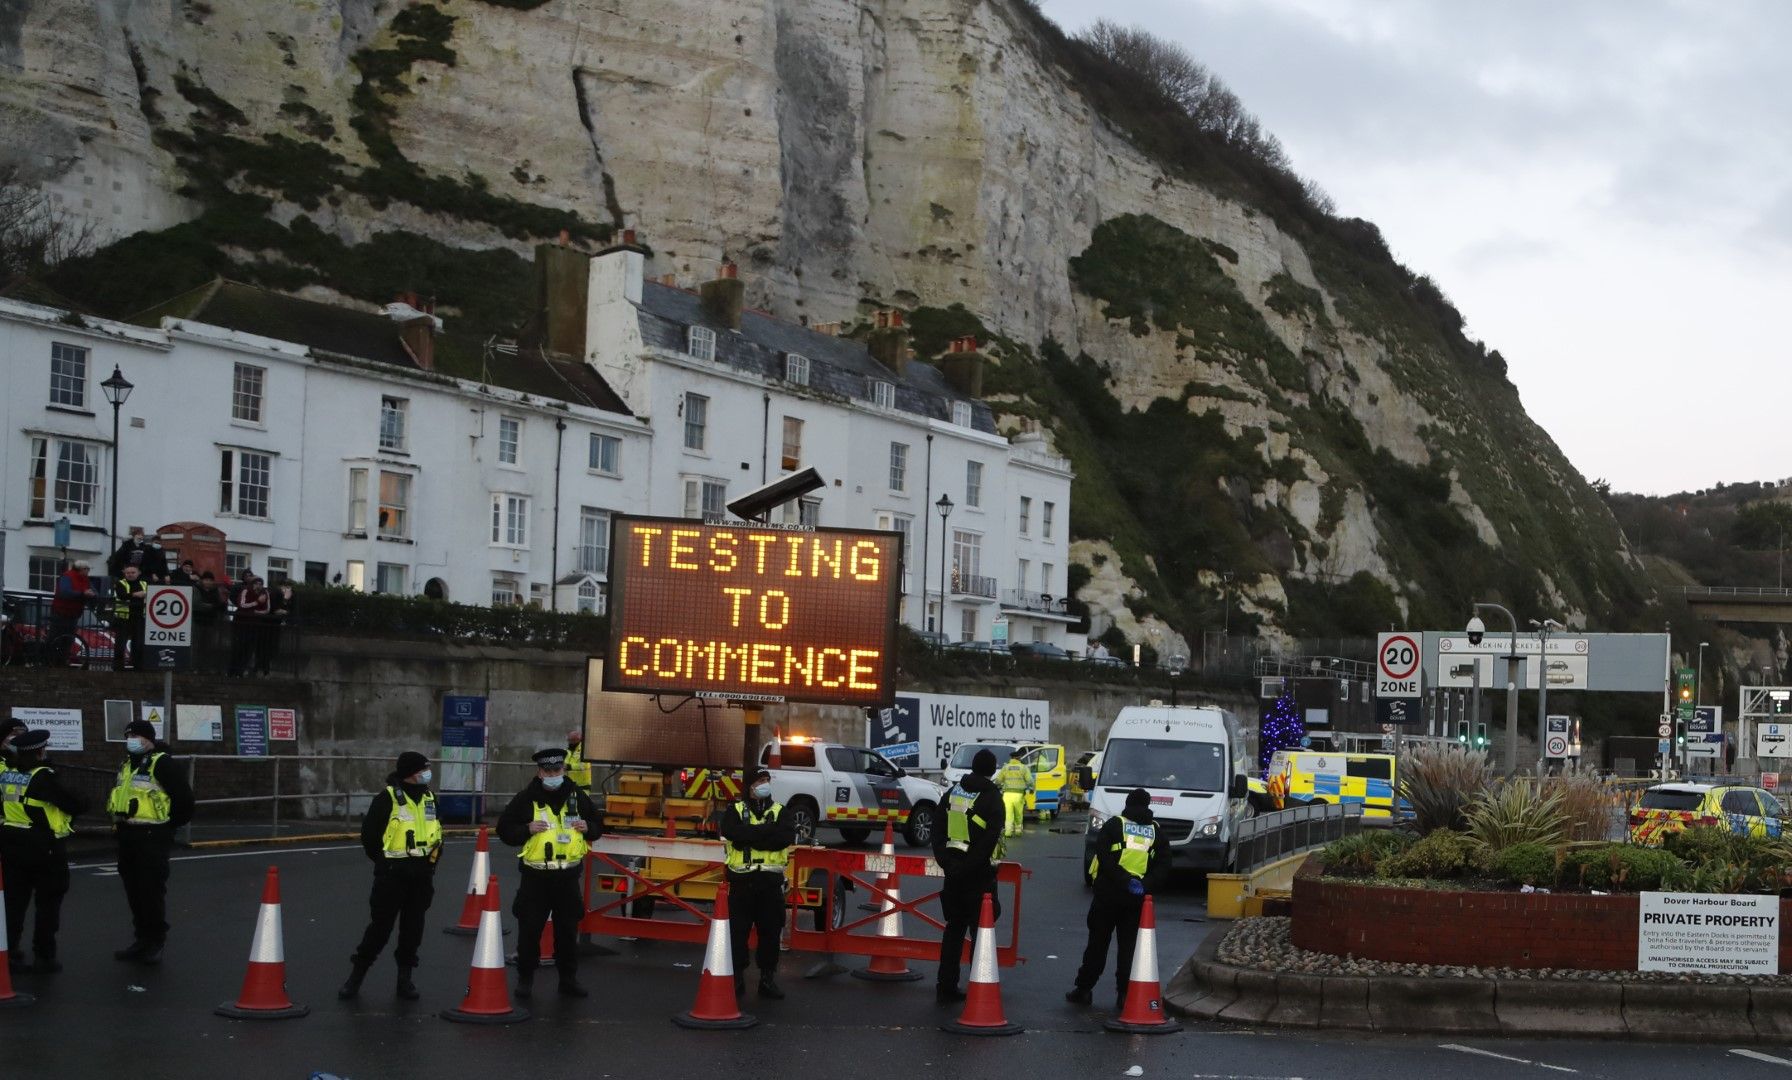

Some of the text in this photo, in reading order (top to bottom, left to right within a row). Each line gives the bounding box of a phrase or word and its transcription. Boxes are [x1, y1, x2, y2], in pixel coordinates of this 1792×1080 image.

[633, 527, 880, 581] TESTING
[156, 600, 183, 616] 20
[723, 588, 789, 629] TO
[149, 631, 186, 642] ZONE
[620, 636, 879, 690] COMMENCE
[1386, 647, 1413, 665] 20
[1381, 682, 1417, 693] ZONE
[930, 703, 1041, 729] Welcome to the
[1183, 720, 1213, 729] Vehicle
[1551, 742, 1562, 750] 20
[1125, 823, 1153, 837] POLICE
[1730, 899, 1756, 907] Board
[1644, 913, 1775, 927] PRIVATE PROPERTY
